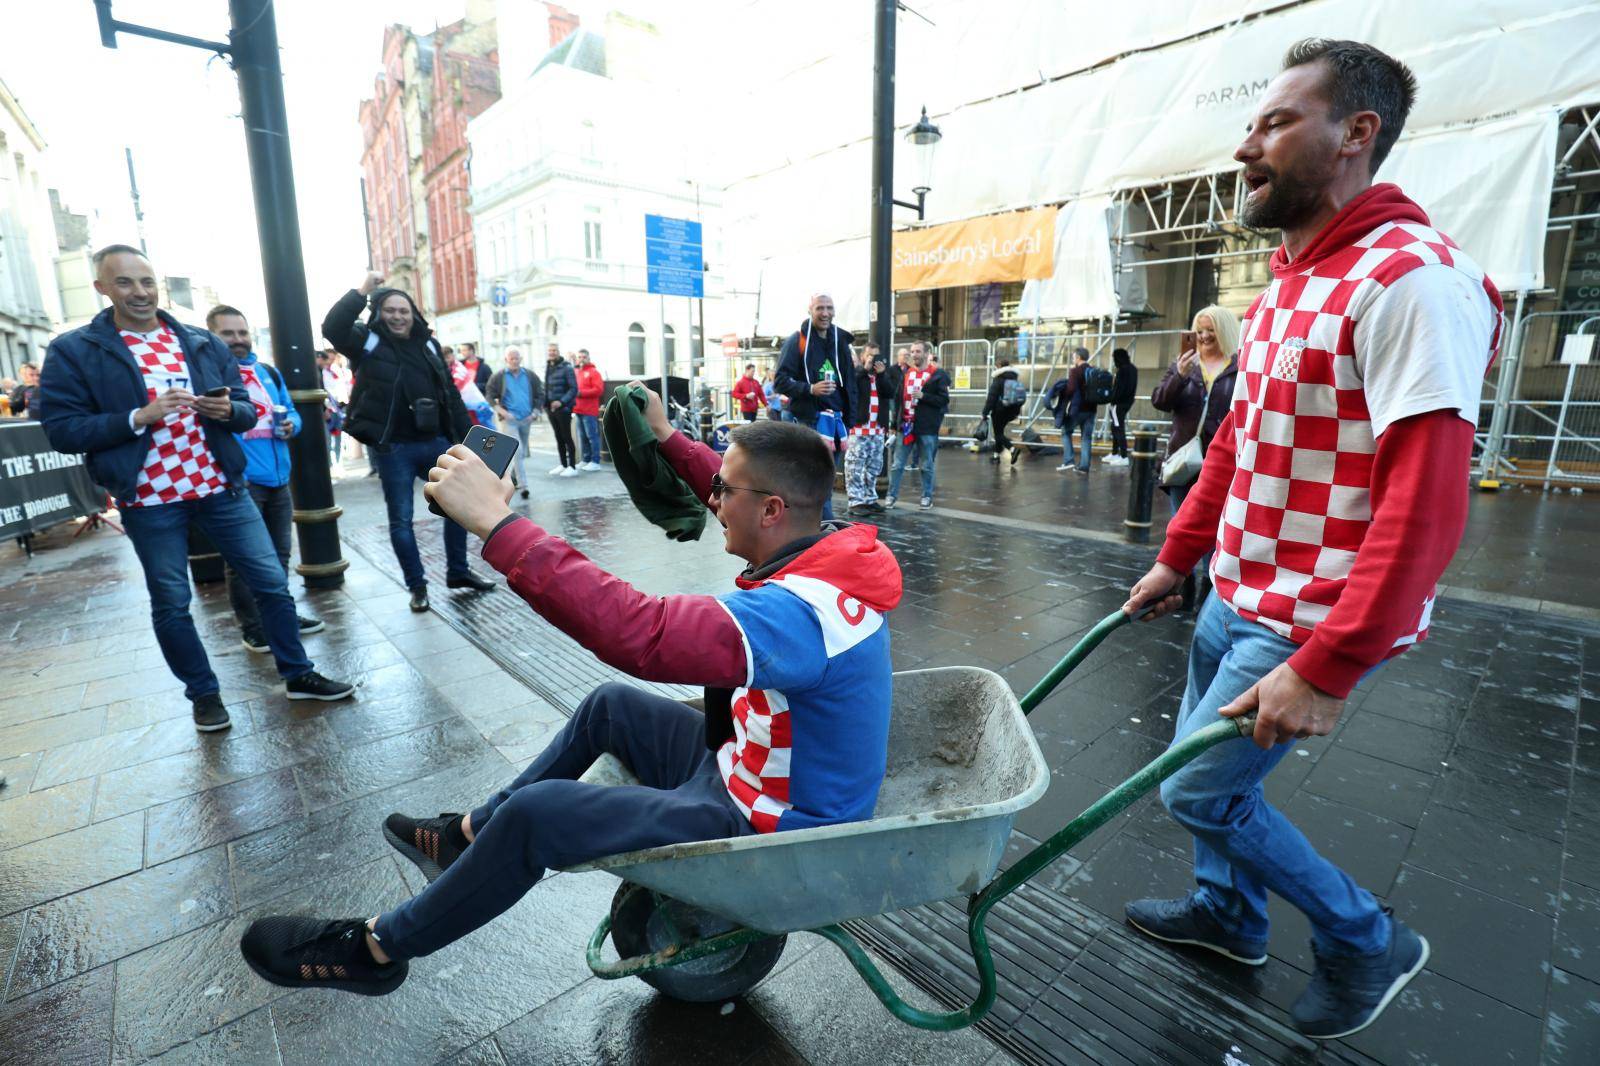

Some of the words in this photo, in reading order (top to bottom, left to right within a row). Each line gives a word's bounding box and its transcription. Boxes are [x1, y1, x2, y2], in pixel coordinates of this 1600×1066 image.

[1195, 79, 1268, 108] PARAM
[895, 241, 989, 268] Sainsbury's
[992, 230, 1041, 257] Local
[2, 455, 34, 478] THE
